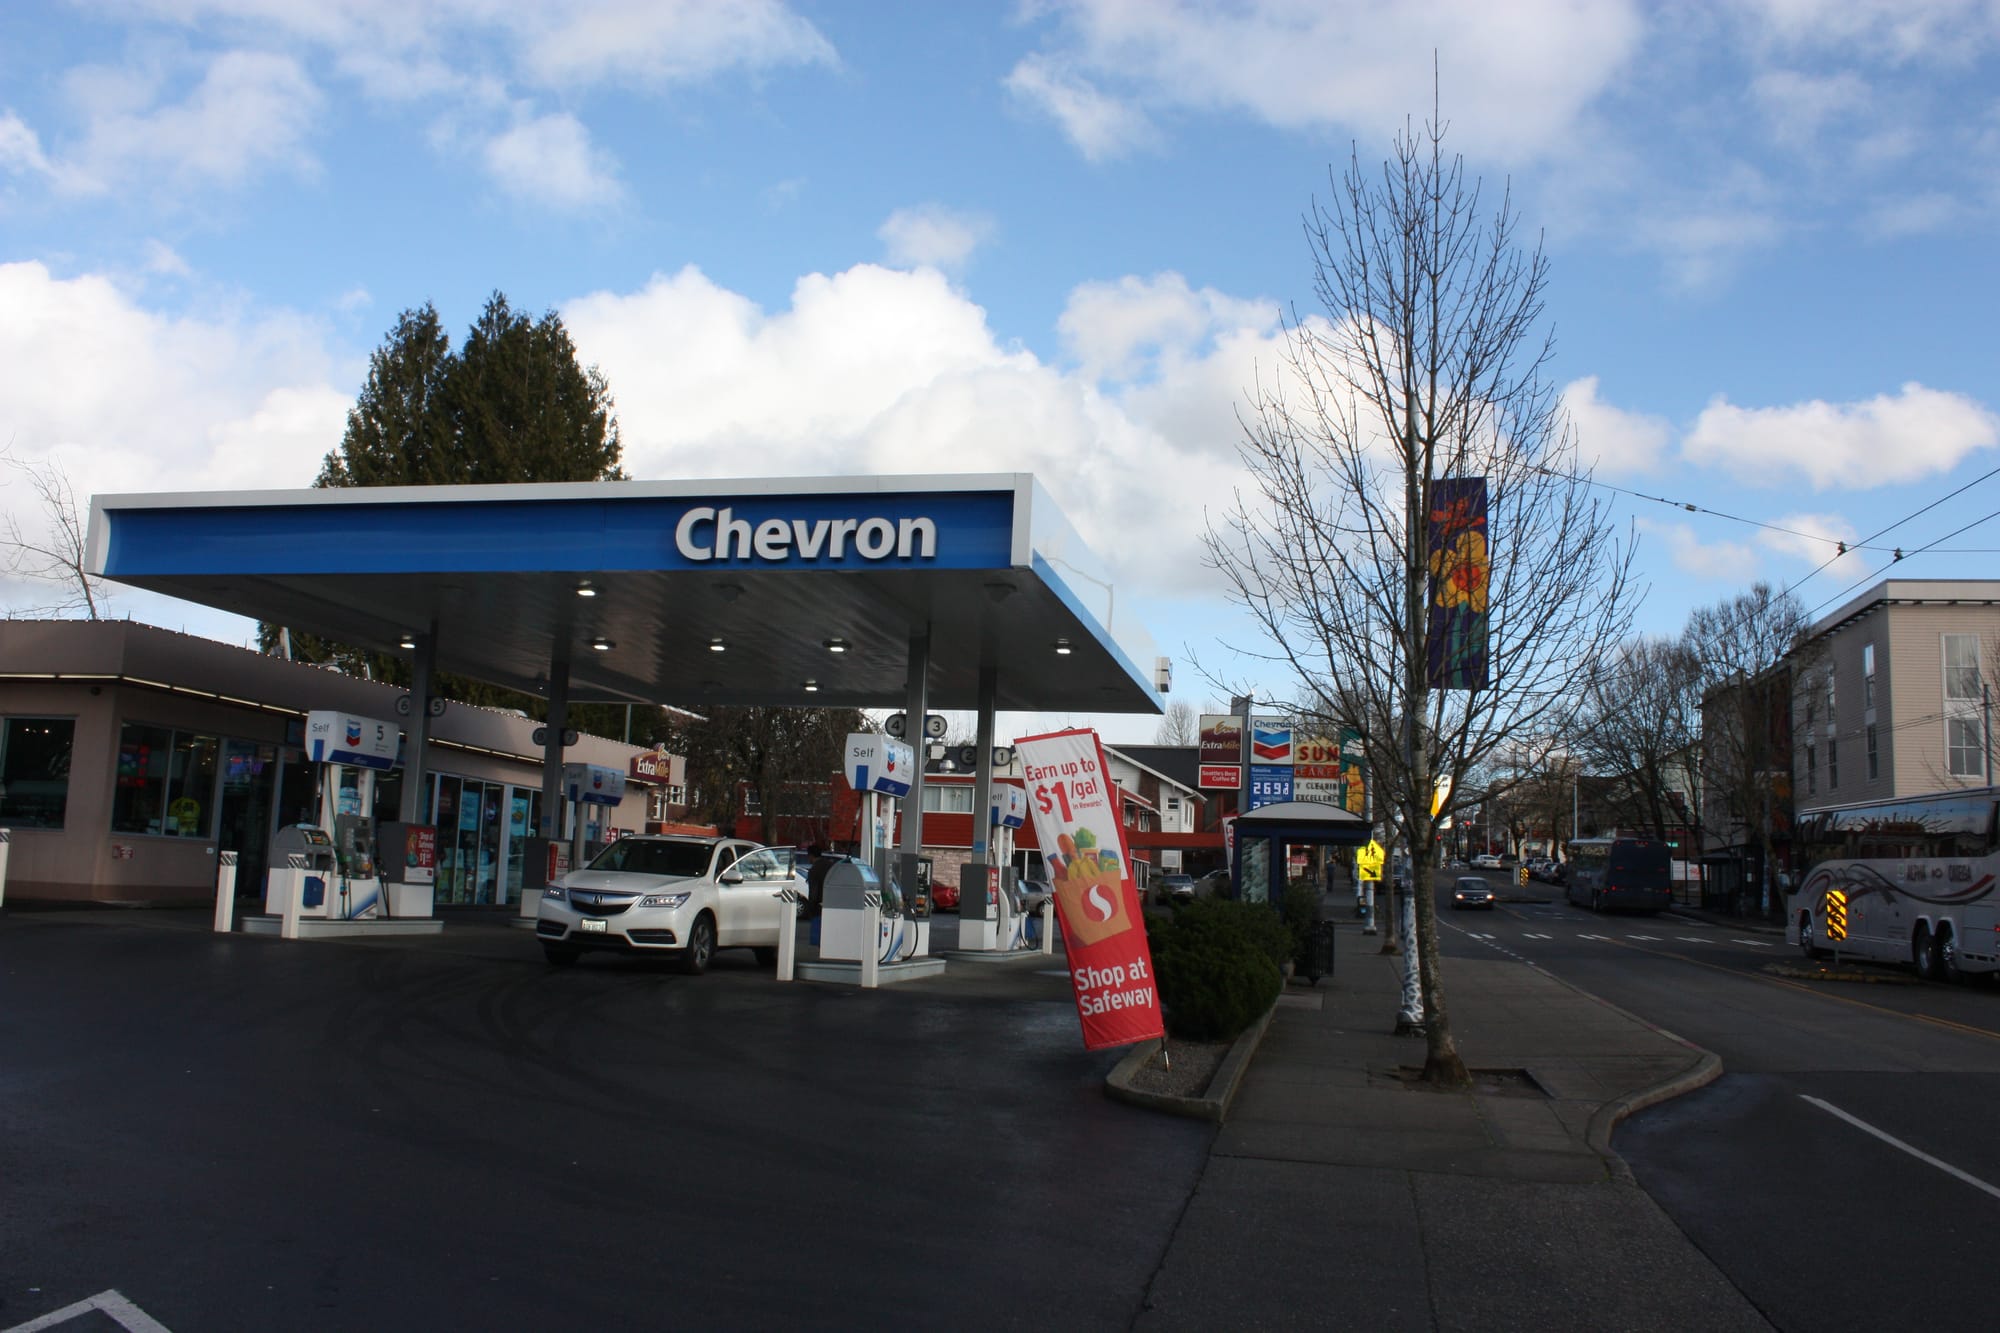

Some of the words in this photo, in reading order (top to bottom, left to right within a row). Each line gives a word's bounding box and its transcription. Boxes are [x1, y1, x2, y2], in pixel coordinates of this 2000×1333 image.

[675, 507, 937, 560] Chevron
[400, 701, 408, 710] 6
[434, 701, 441, 711] 5
[312, 723, 330, 733] Self
[891, 720, 899, 731] 4
[933, 721, 940, 731] 3
[1254, 720, 1292, 728] Chevron
[376, 725, 384, 740] 5
[1201, 741, 1240, 750] ExtraMile
[853, 747, 874, 758] Self
[965, 751, 972, 760] 2
[1000, 751, 1004, 761] 1
[1299, 746, 1339, 761] SUN
[637, 758, 669, 777] ExtraMile
[1024, 764, 1058, 782] Earn
[1060, 762, 1078, 781] up
[1080, 757, 1096, 773] to
[992, 793, 1003, 801] elf
[1035, 781, 1073, 823] $1
[1070, 778, 1098, 801] /gal
[1074, 966, 1125, 991] Shop
[1128, 956, 1148, 981] at
[1079, 986, 1153, 1017] Safeway
